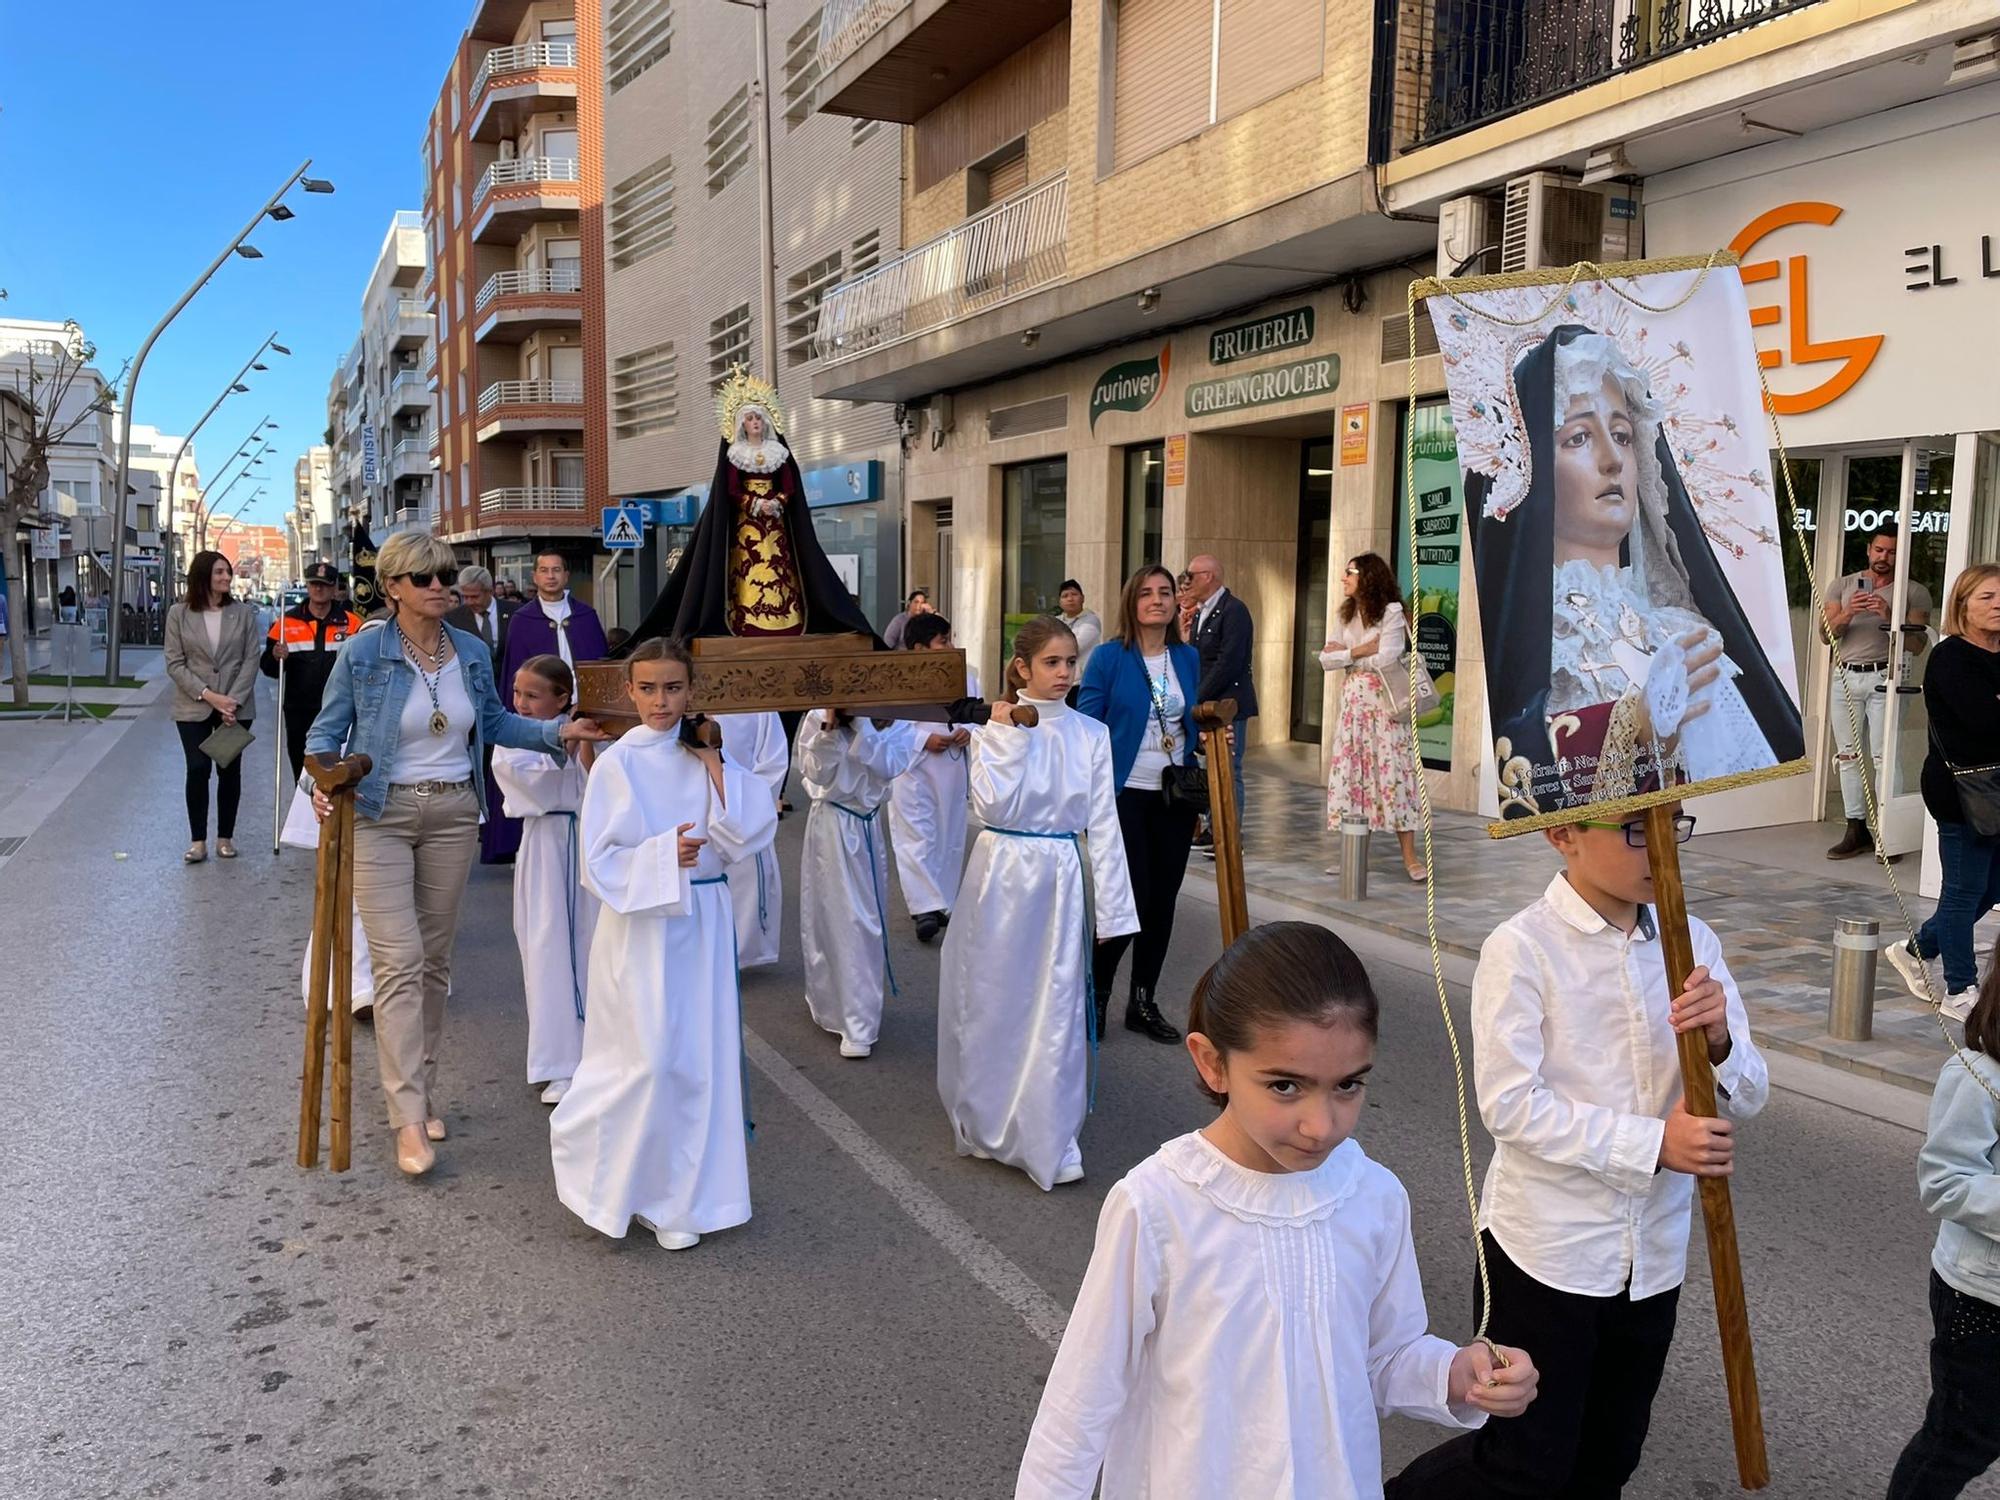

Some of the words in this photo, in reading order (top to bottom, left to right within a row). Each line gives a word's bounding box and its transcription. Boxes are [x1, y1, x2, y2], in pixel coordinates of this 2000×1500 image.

[1905, 245, 1958, 290] EL
[1212, 312, 1309, 361] FRUTERIA
[1093, 372, 1159, 406] surinver
[1191, 360, 1331, 413] GREENGROCER
[364, 426, 375, 481] DENTISTA
[1413, 436, 1456, 455] surinve
[1427, 492, 1444, 508] SANO
[1422, 516, 1451, 533] SABROSO
[1420, 548, 1453, 561] NUTRITIVO
[1515, 757, 1573, 780] Cofradía
[1631, 743, 1647, 759] de
[1647, 740, 1667, 755] los
[1511, 781, 1560, 799] Dolores
[1561, 779, 1573, 793] y
[1555, 798, 1564, 809] y
[1566, 784, 1638, 807] Evangelista
